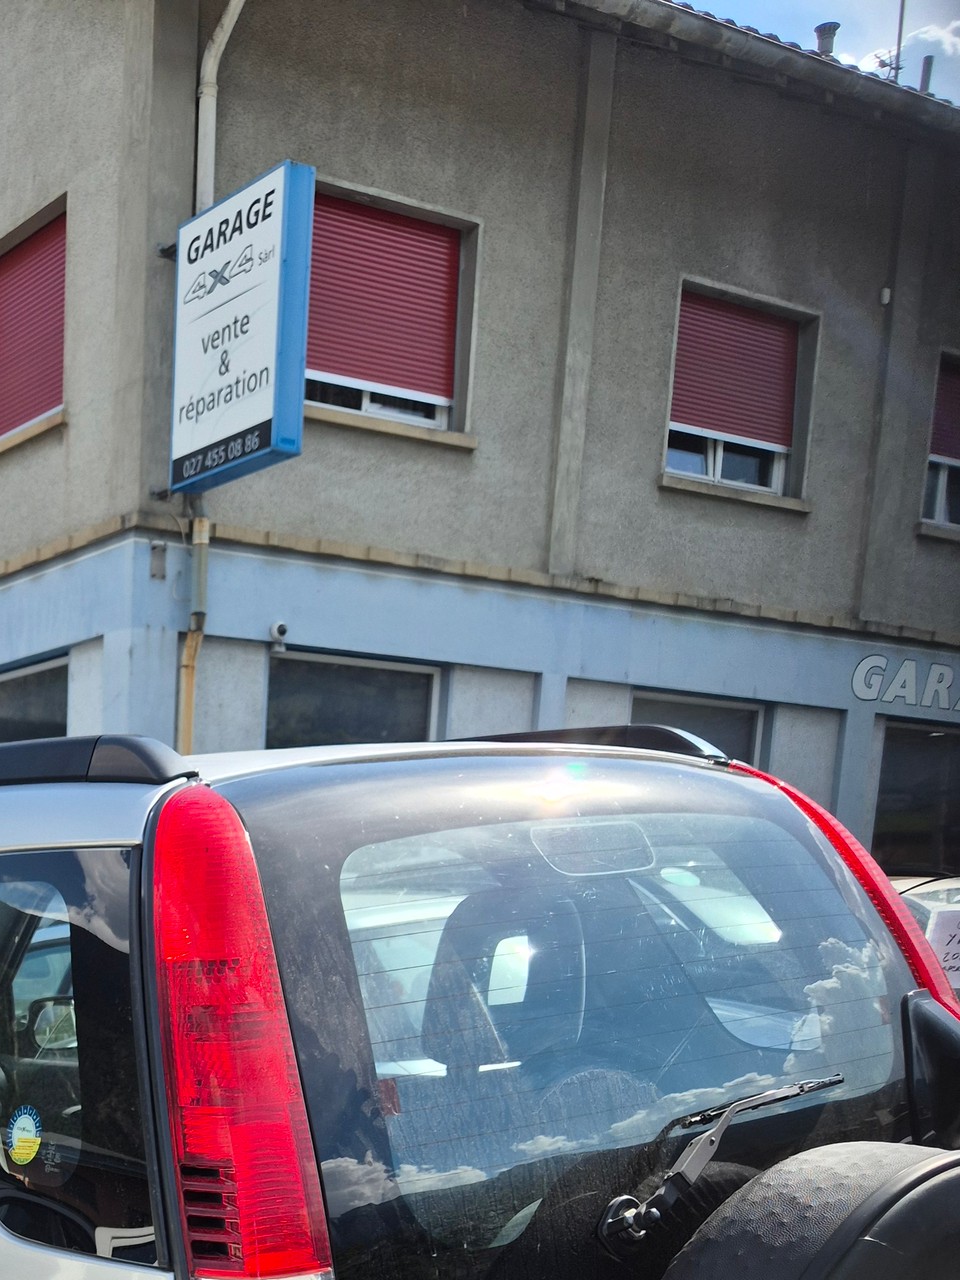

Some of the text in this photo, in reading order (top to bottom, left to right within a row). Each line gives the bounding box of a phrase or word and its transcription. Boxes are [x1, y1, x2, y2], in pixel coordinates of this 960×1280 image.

[187, 188, 276, 265] GARAGE
[201, 314, 251, 355] vente
[218, 349, 231, 377] &
[178, 366, 270, 424] réparation
[182, 430, 261, 479] 027 455 08 86
[851, 653, 960, 711] GAR
